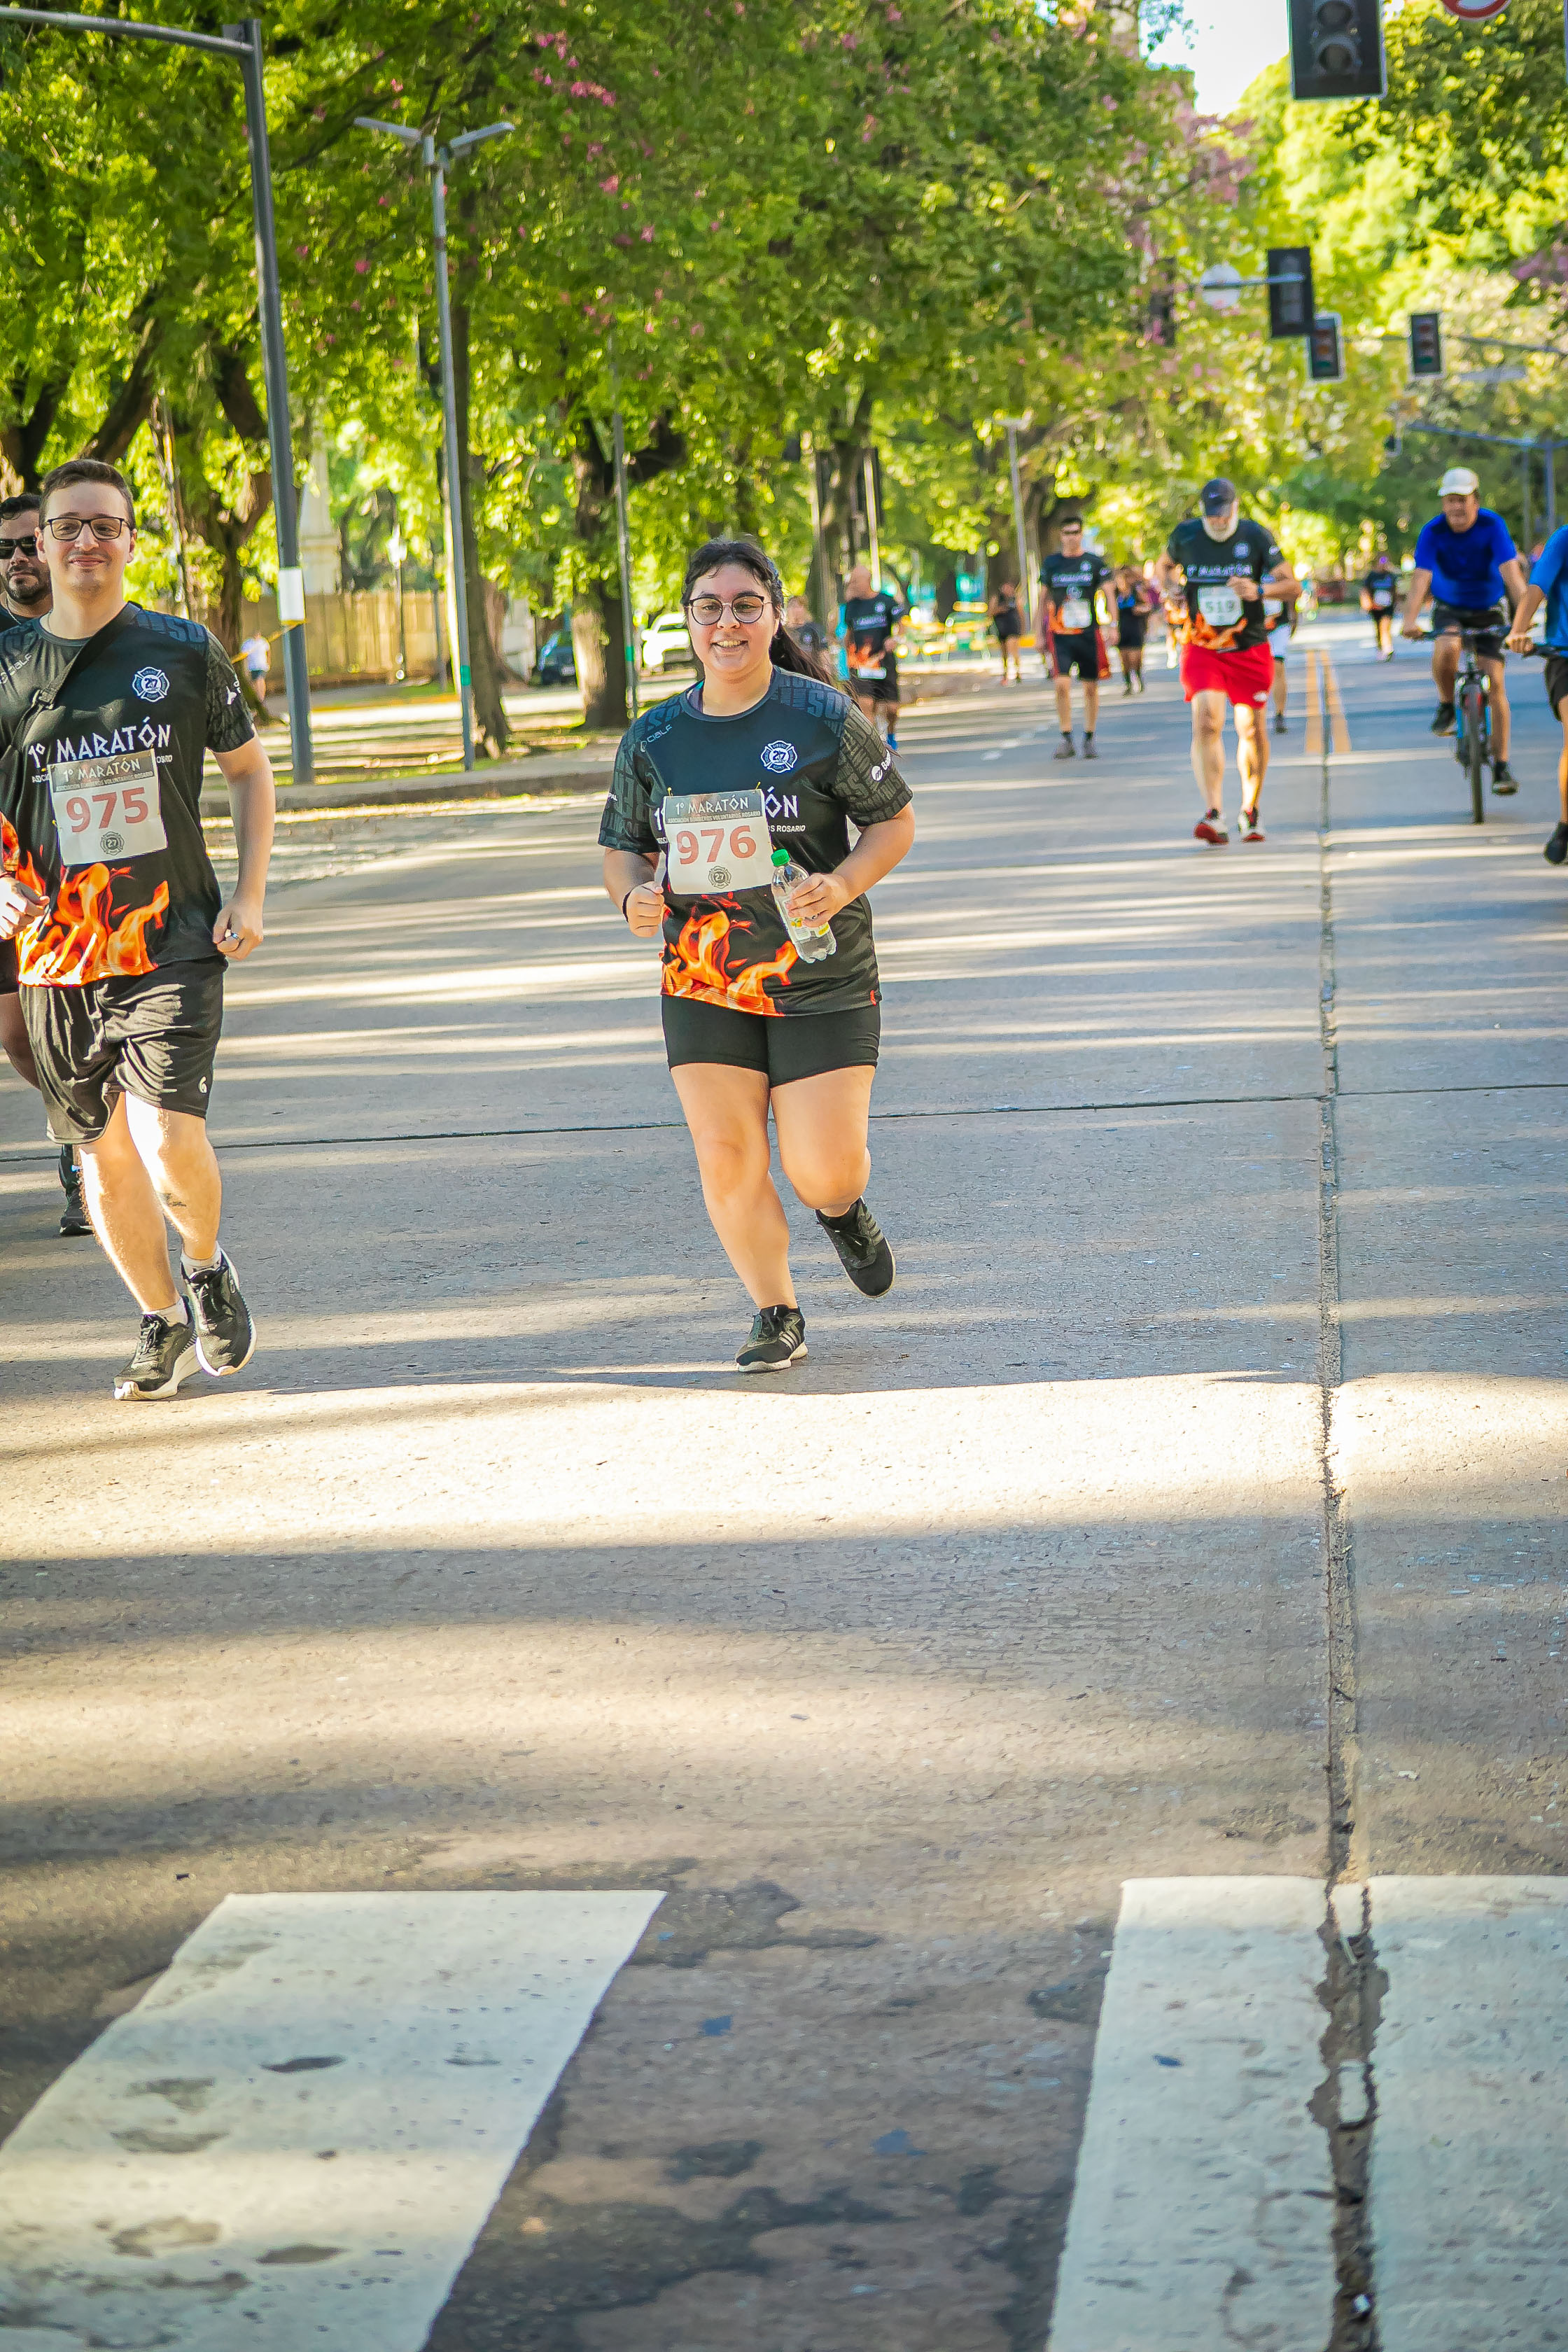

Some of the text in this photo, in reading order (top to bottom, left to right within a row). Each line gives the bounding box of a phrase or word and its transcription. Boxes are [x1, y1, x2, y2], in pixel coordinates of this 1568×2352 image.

[57, 716, 171, 762] MARATÓN
[647, 724, 672, 743] CIALF
[773, 750, 787, 761] 27
[64, 769, 74, 782] 1º
[78, 757, 141, 780] MARATÓN
[66, 787, 149, 833] 975
[676, 802, 685, 816] 1º
[688, 794, 749, 814] MARATÓN
[776, 825, 806, 833] ROSARIO
[676, 825, 757, 864] 976
